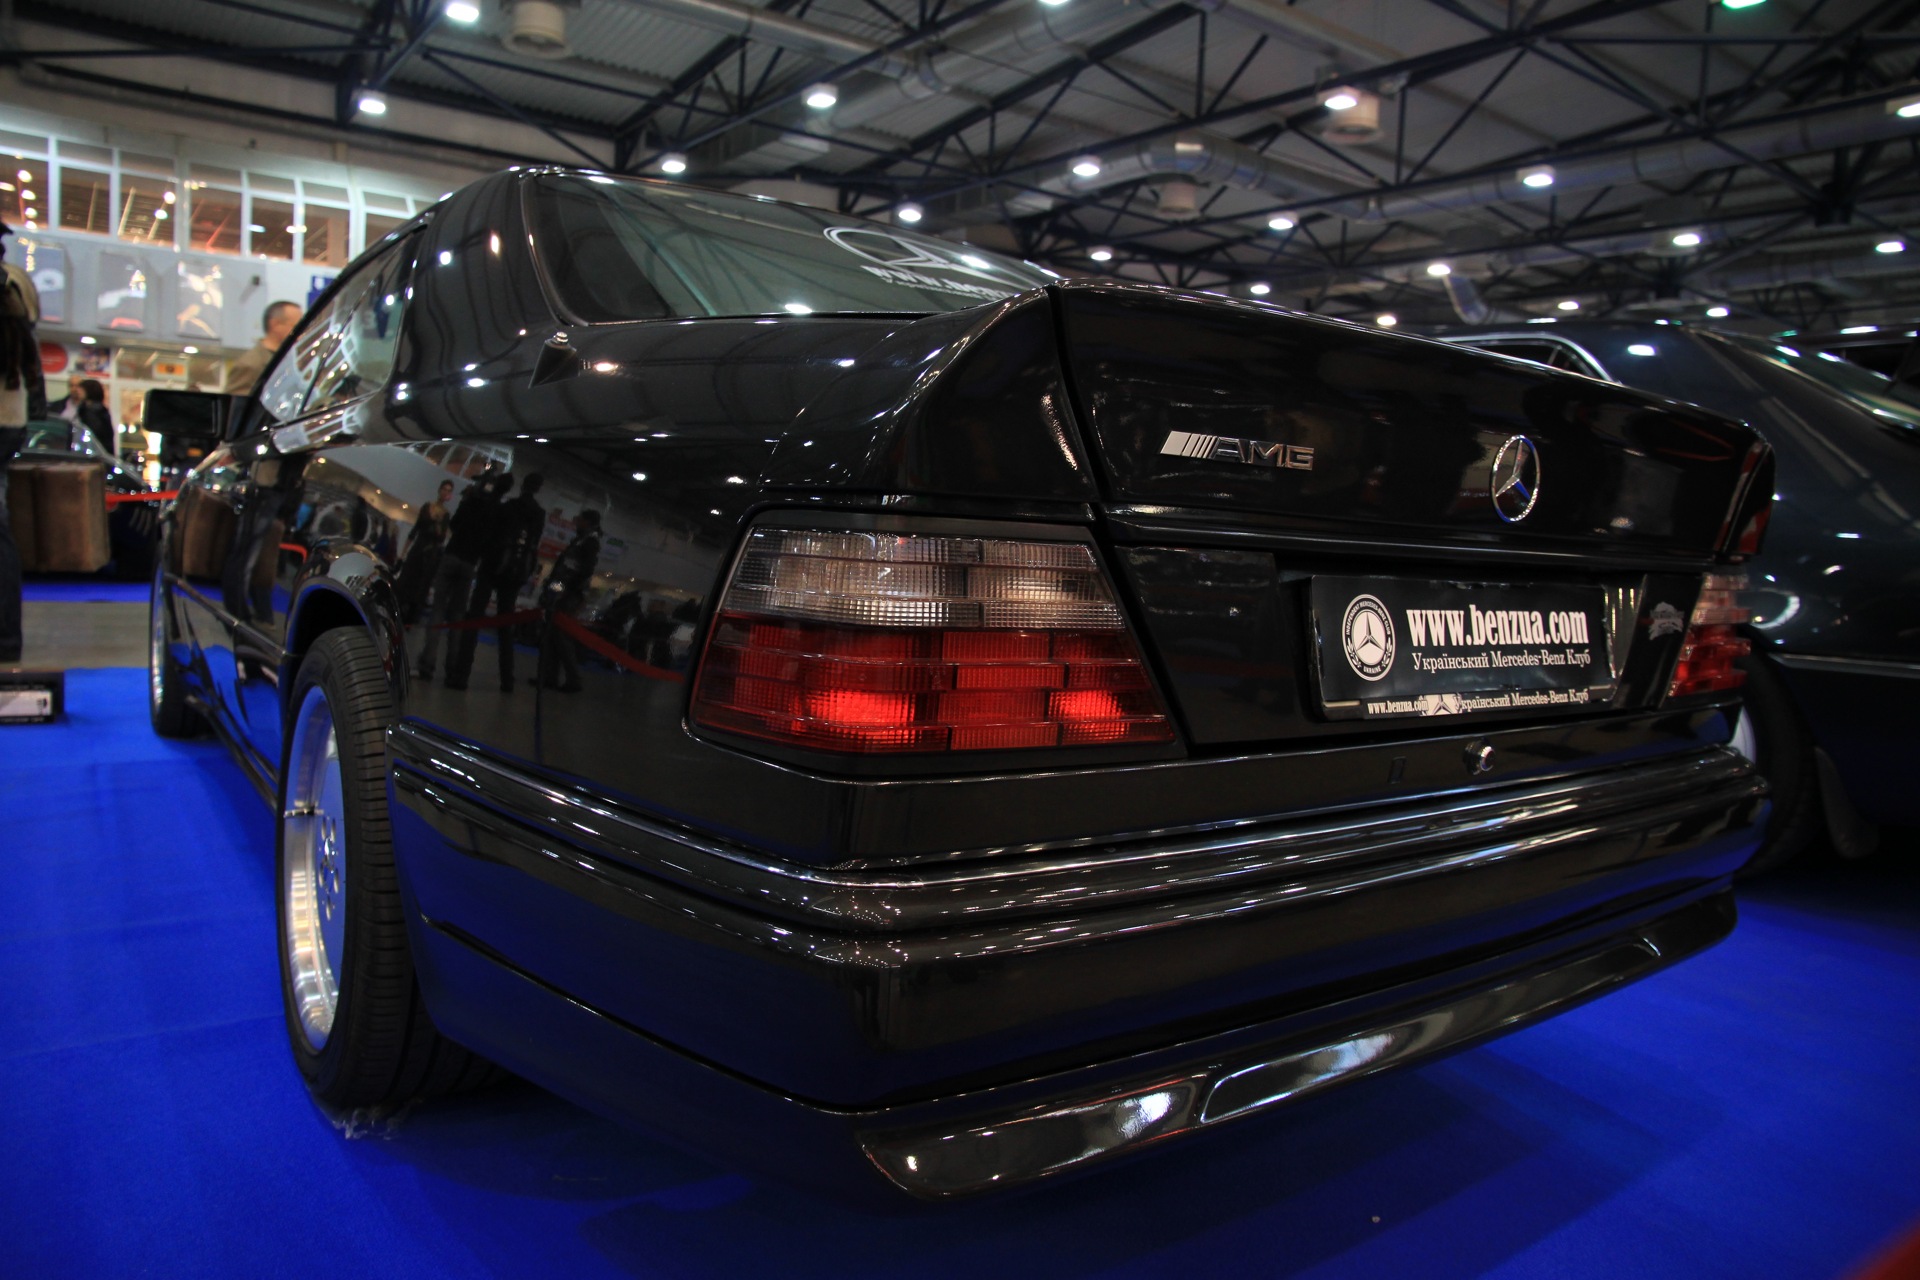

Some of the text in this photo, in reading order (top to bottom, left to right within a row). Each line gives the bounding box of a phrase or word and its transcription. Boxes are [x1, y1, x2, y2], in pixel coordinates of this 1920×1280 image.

[1208, 436, 1315, 471] AMG
[1406, 604, 1589, 647] www.benzua.com
[1363, 665, 1382, 674] UKRAINE
[1412, 648, 1591, 674] Український Mercedes-Benz Клуб
[1367, 700, 1429, 714] www.benzua.com
[1511, 690, 1569, 707] Mercedes-Benz
